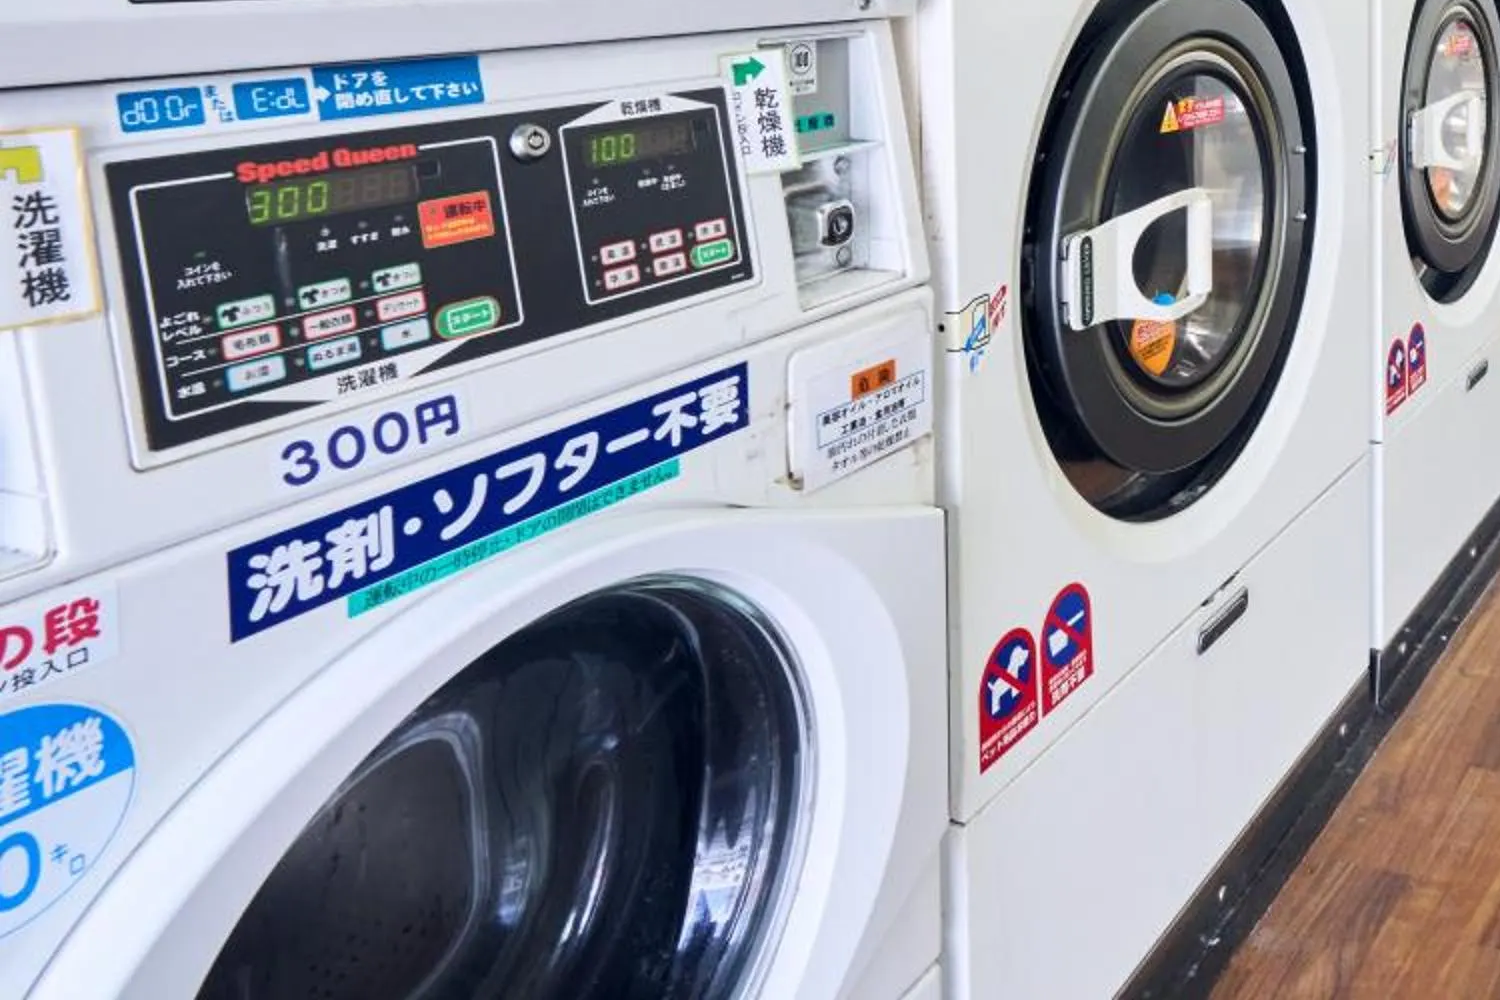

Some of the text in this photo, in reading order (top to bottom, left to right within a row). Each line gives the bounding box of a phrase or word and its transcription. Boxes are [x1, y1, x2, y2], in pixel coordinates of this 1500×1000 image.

[332, 70, 388, 91] ドアを
[334, 80, 480, 111] 閉め直して下さい
[204, 84, 236, 123] または
[620, 98, 663, 117] 乾燥機
[754, 87, 788, 158] 乾燥機
[236, 142, 417, 185] Speed Queen
[590, 132, 636, 165] 100
[248, 180, 329, 225] 300
[11, 190, 71, 308] 洗濯機
[159, 310, 200, 329] よごれ
[162, 323, 202, 341] レベル
[451, 307, 490, 326] スタート
[166, 349, 207, 367] コース
[336, 363, 399, 394] 洗濯機
[280, 394, 462, 488] 300円
[247, 374, 742, 622] 洗剤・ソフター不要
[0, 597, 101, 672] の段
[0, 646, 90, 694] 投入口
[49, 843, 88, 876] キロ
